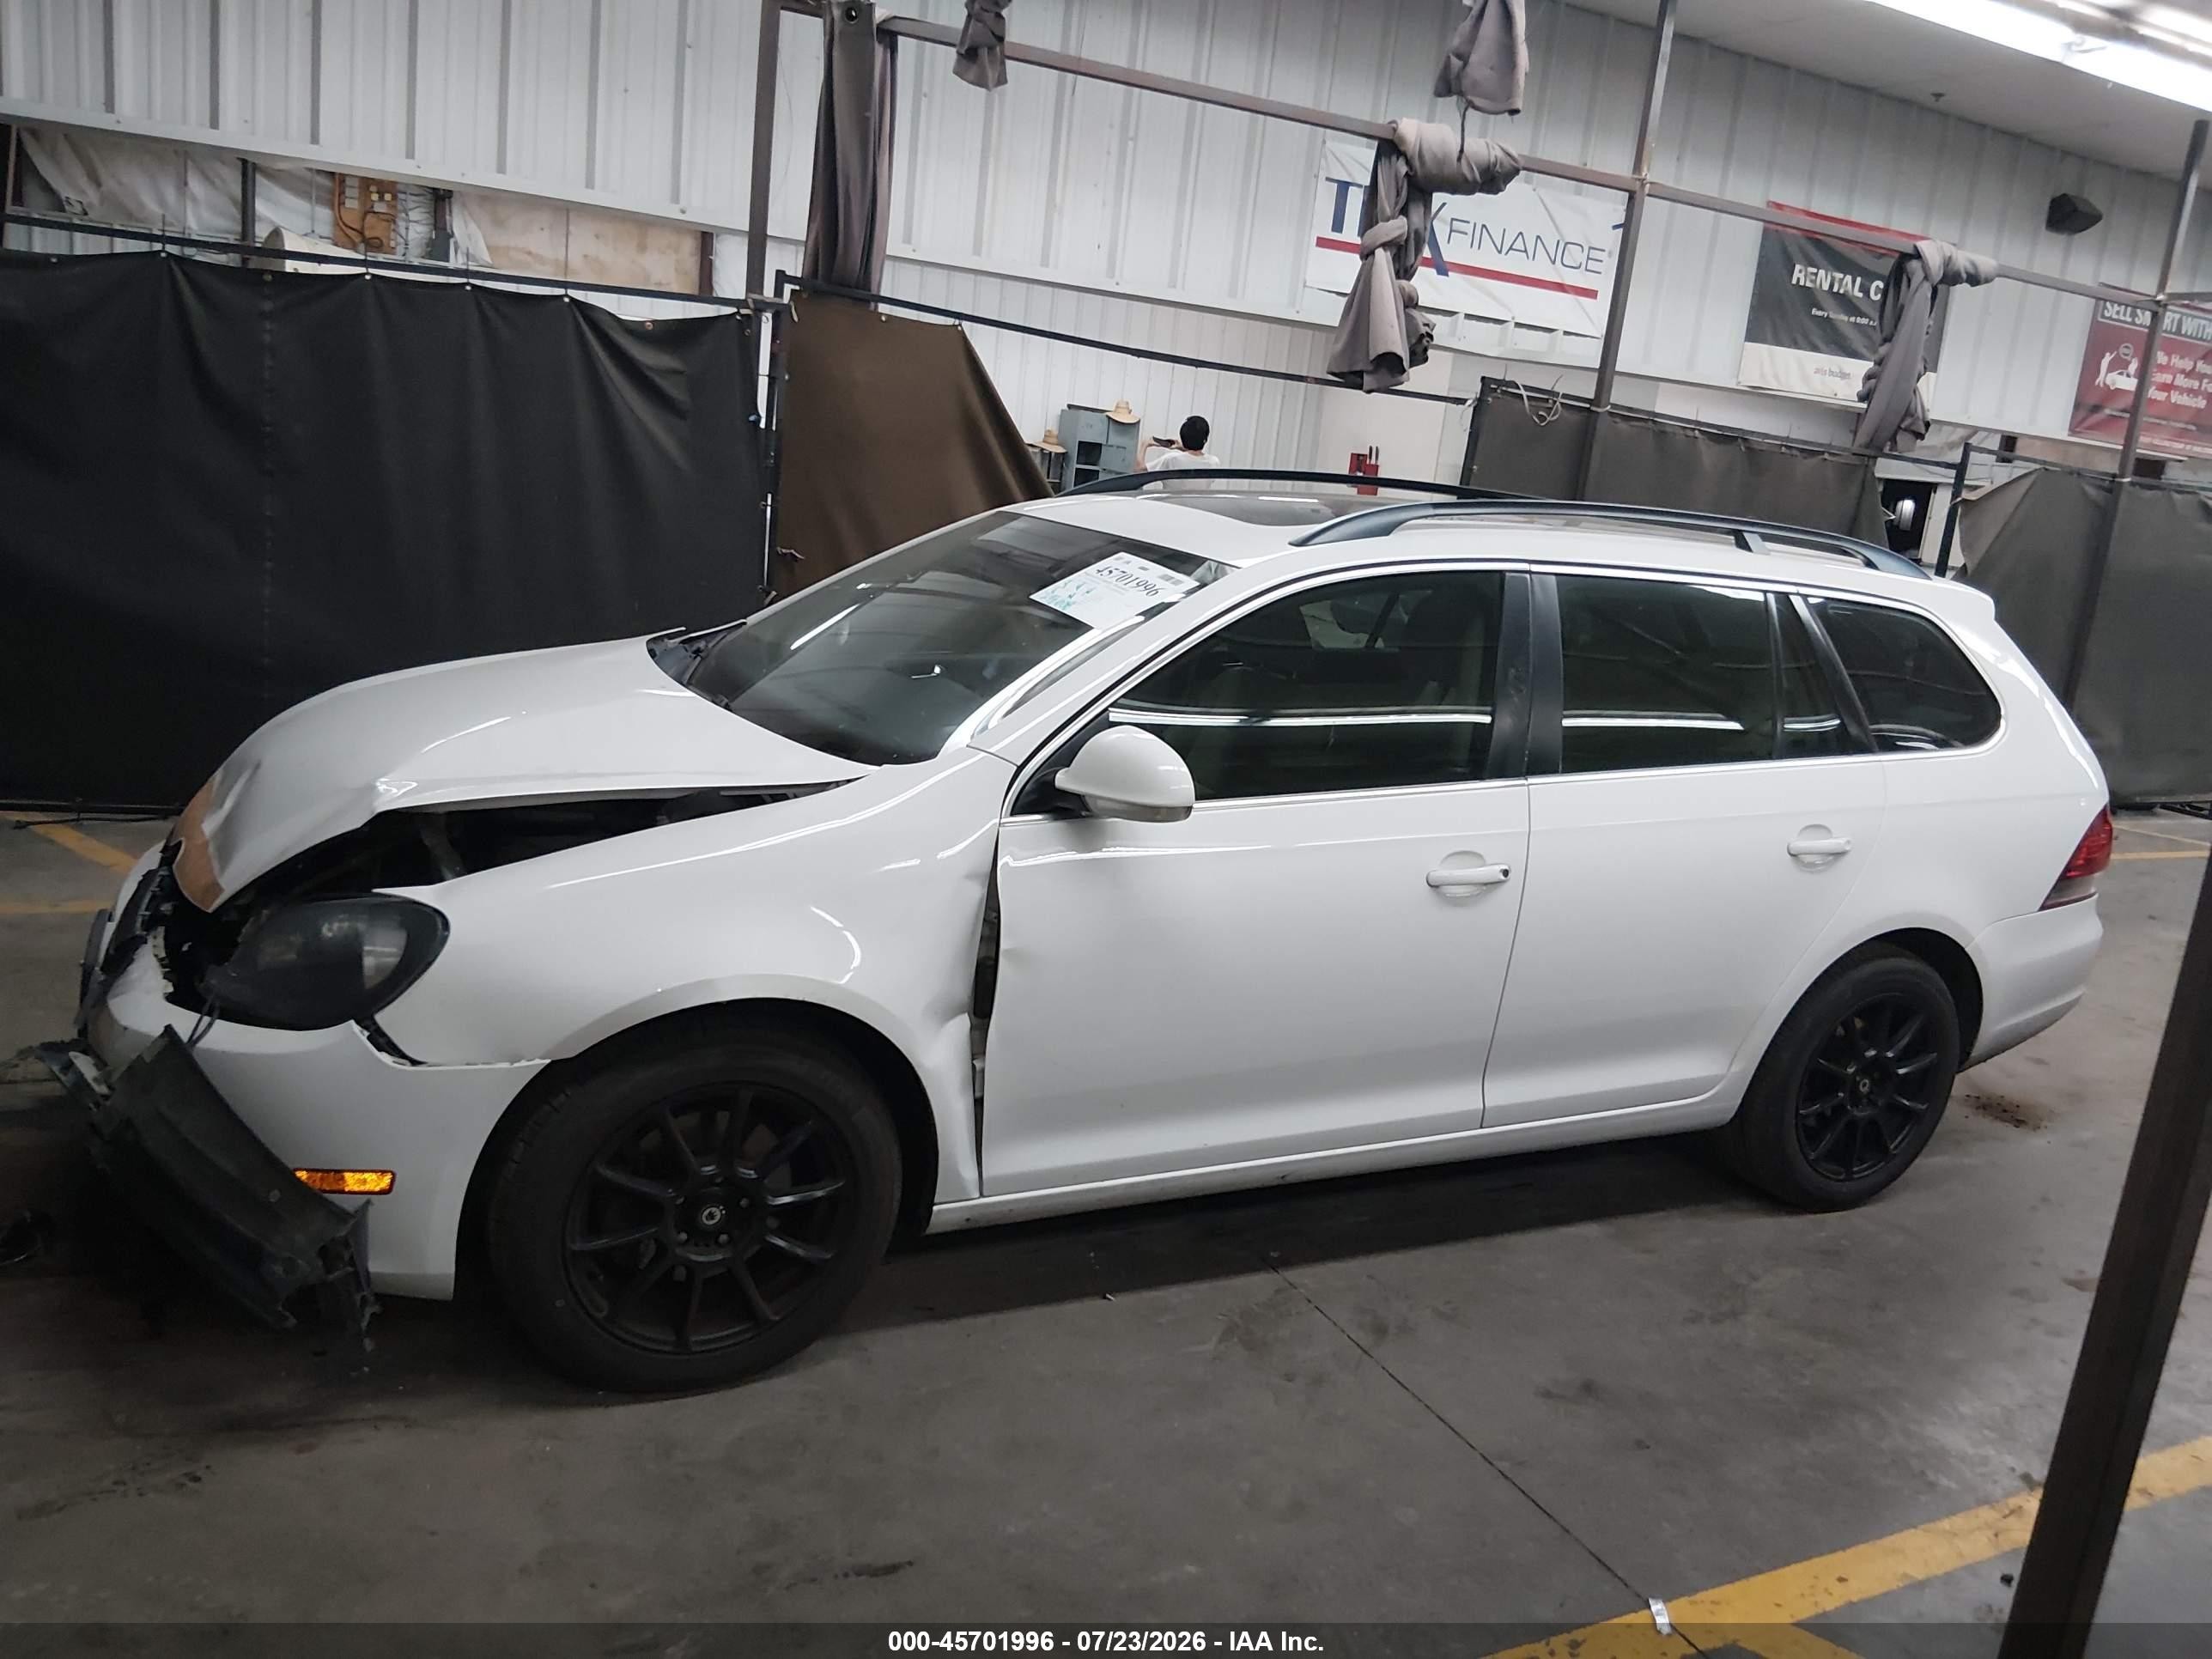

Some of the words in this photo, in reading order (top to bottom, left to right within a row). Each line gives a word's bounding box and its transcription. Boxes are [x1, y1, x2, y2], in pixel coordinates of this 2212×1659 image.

[1447, 217, 1606, 275] FINANCE
[1791, 264, 1863, 298] RENTAL
[1869, 280, 1884, 301] C
[2104, 301, 2133, 322] SELL
[1096, 566, 1164, 597] 45701996
